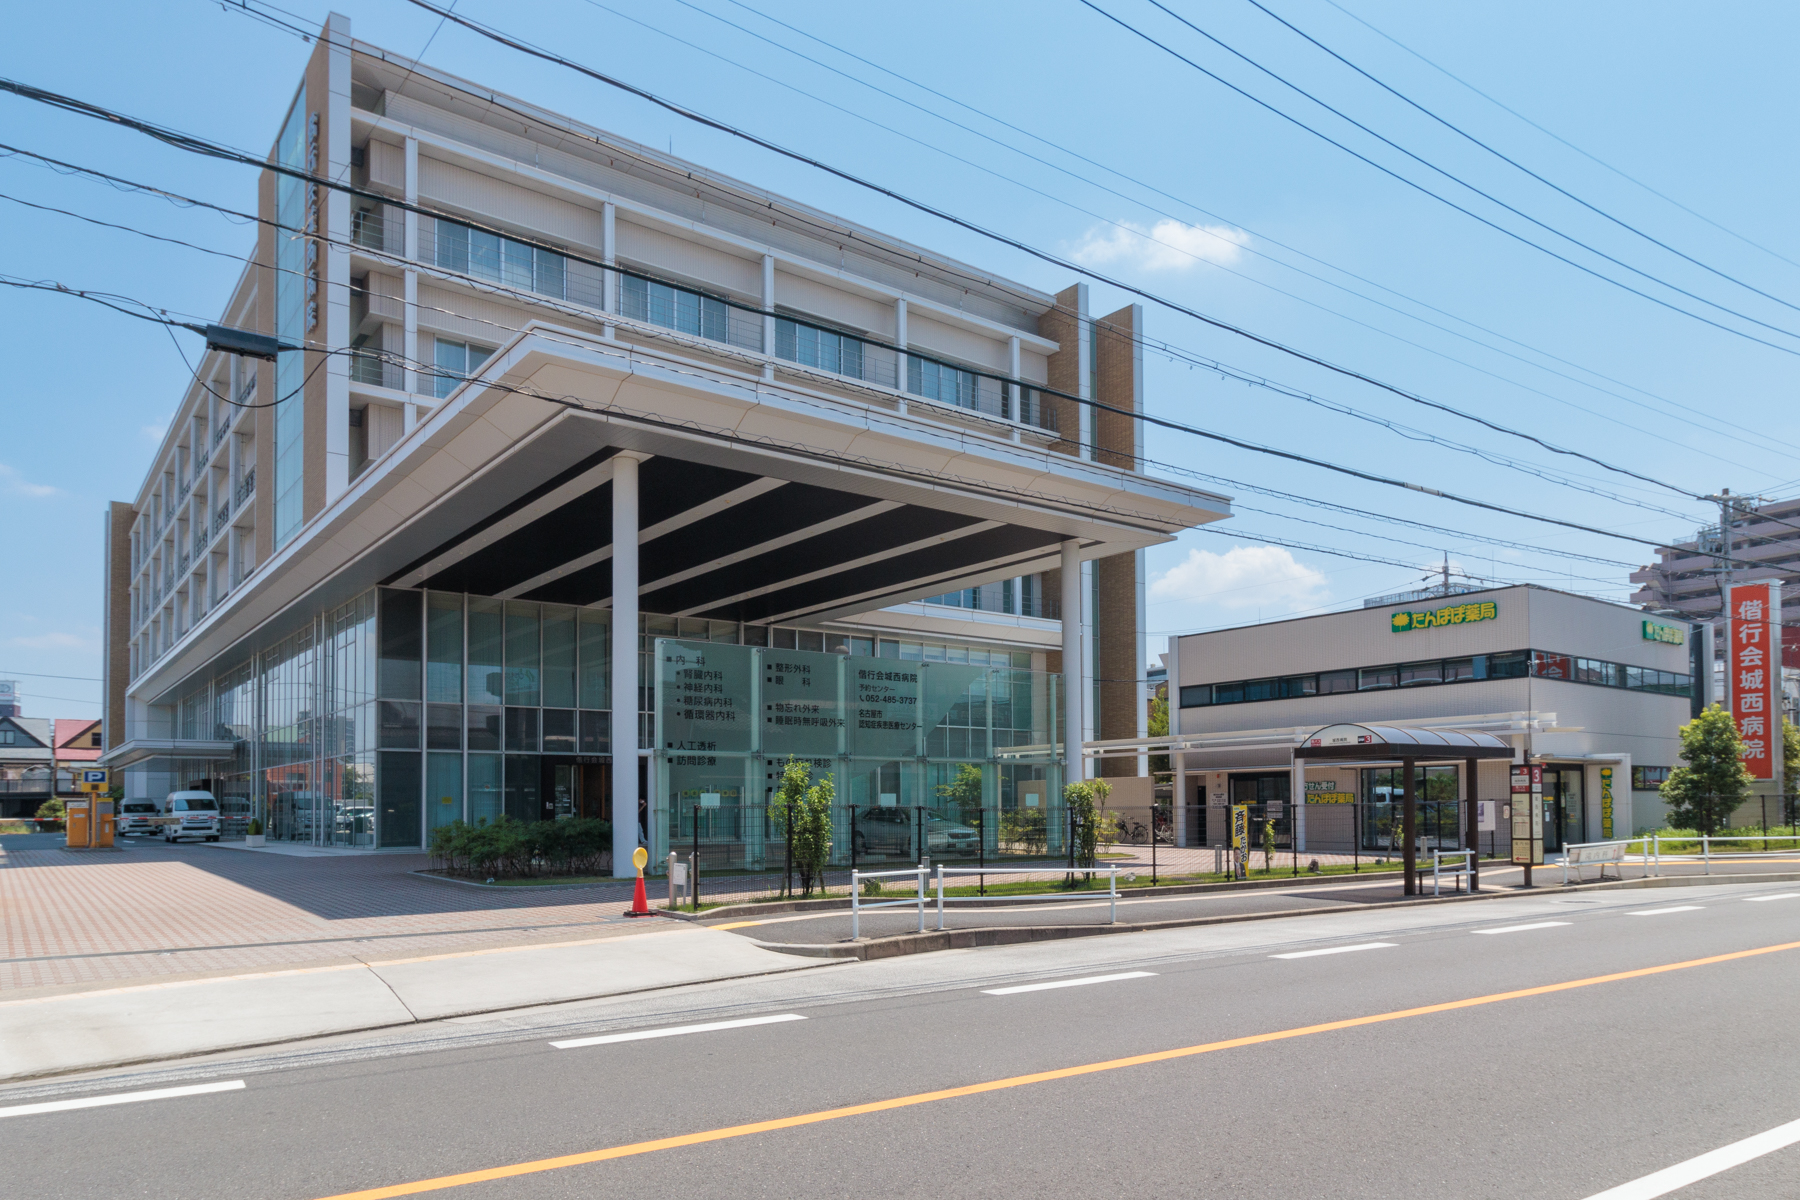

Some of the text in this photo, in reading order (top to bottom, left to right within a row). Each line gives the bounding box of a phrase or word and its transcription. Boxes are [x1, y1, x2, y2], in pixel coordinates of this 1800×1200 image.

[1411, 602, 1496, 628] たんぽぽ薬局
[683, 668, 723, 681] 腎臓内科
[775, 663, 811, 674] 整形外科
[858, 669, 918, 684] 偕行会城西病院
[1738, 599, 1765, 759] 偕行会城西病院
[683, 682, 723, 694] 神経内科
[858, 683, 896, 693] 予約センター
[683, 695, 733, 708] 糖尿病内科
[865, 694, 917, 705] 052-485-3737
[775, 702, 820, 714] 物忘れ外来
[858, 708, 883, 719] 名古屋市
[683, 708, 736, 722] 循環器内科
[775, 715, 846, 728] 睡眠時無呼吸外来
[858, 719, 923, 731] 認知症疾患医療センター
[1366, 735, 1371, 743] 3
[676, 740, 717, 752] 人工透析
[676, 755, 717, 766] 訪問診療
[88, 772, 103, 782] P
[1533, 769, 1540, 783] 3
[1307, 792, 1354, 804] たんぽぽ薬局
[1602, 779, 1613, 839] たんぽぽ薬局
